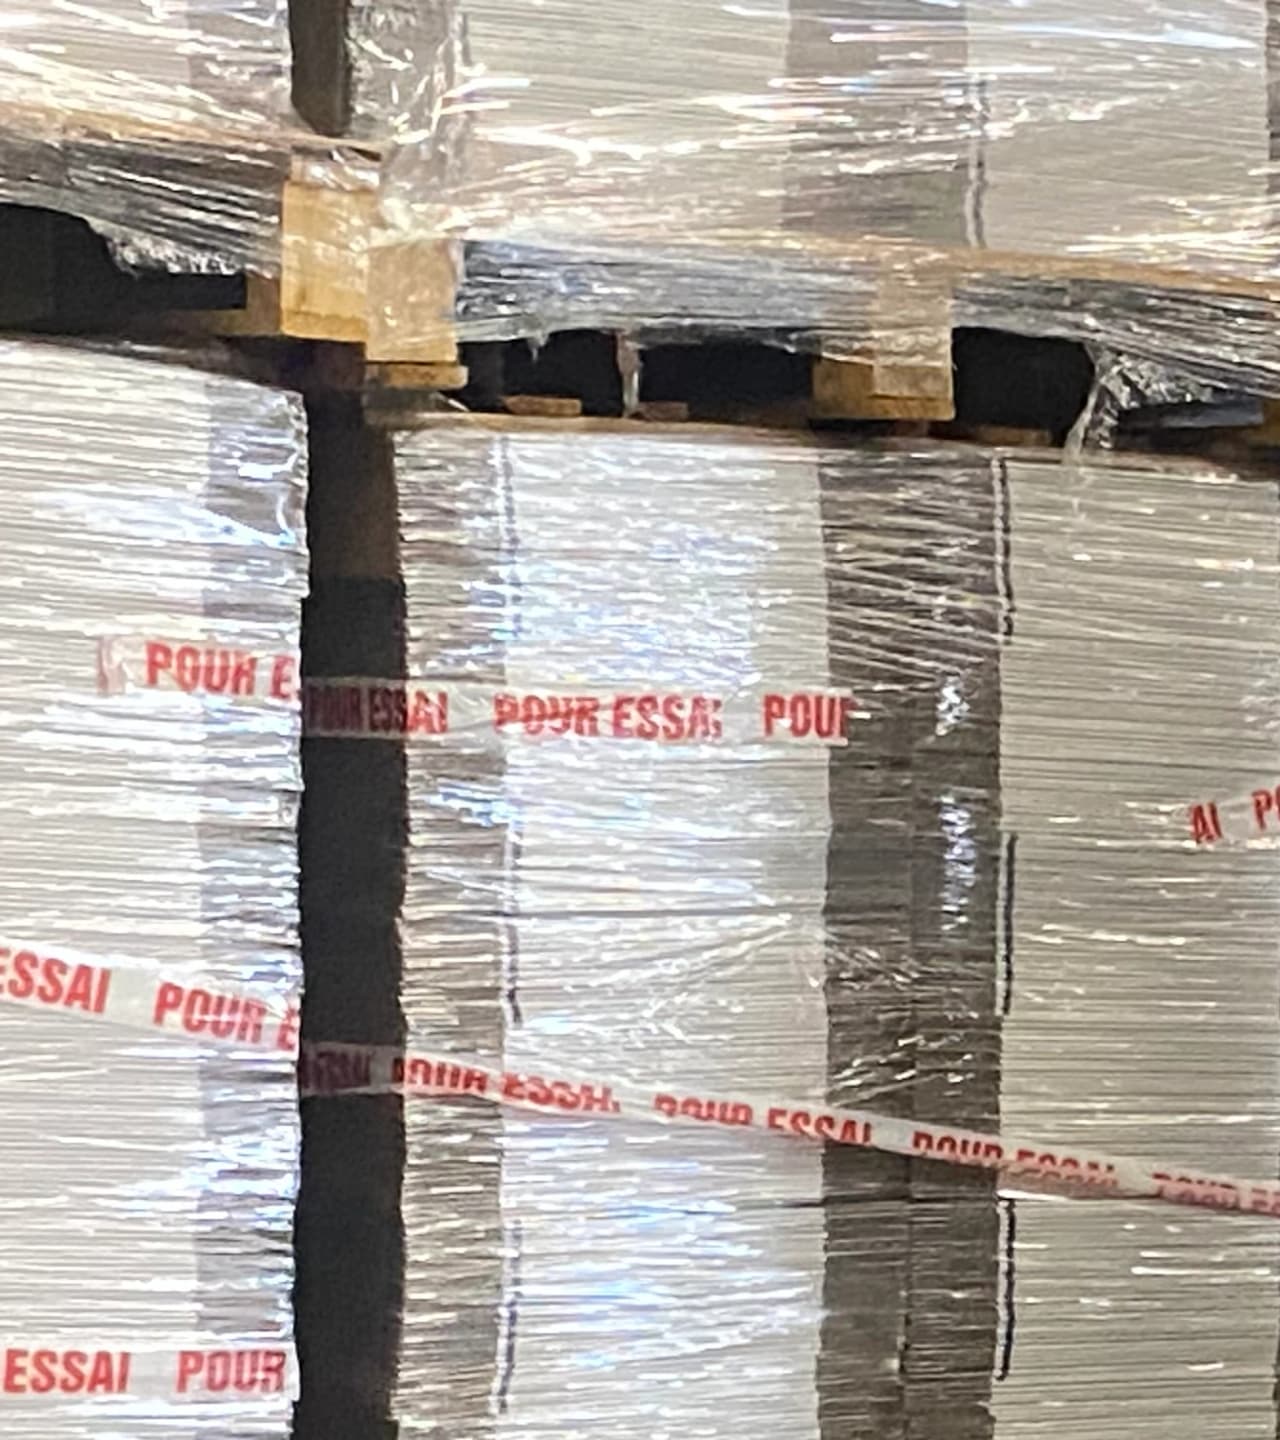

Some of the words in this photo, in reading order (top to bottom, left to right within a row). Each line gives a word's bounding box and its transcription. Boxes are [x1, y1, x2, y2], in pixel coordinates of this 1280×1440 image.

[493, 691, 599, 737] POUR
[153, 981, 268, 1048] POUR
[3, 1348, 132, 1394] ESSAI
[176, 1349, 287, 1393] POUR
